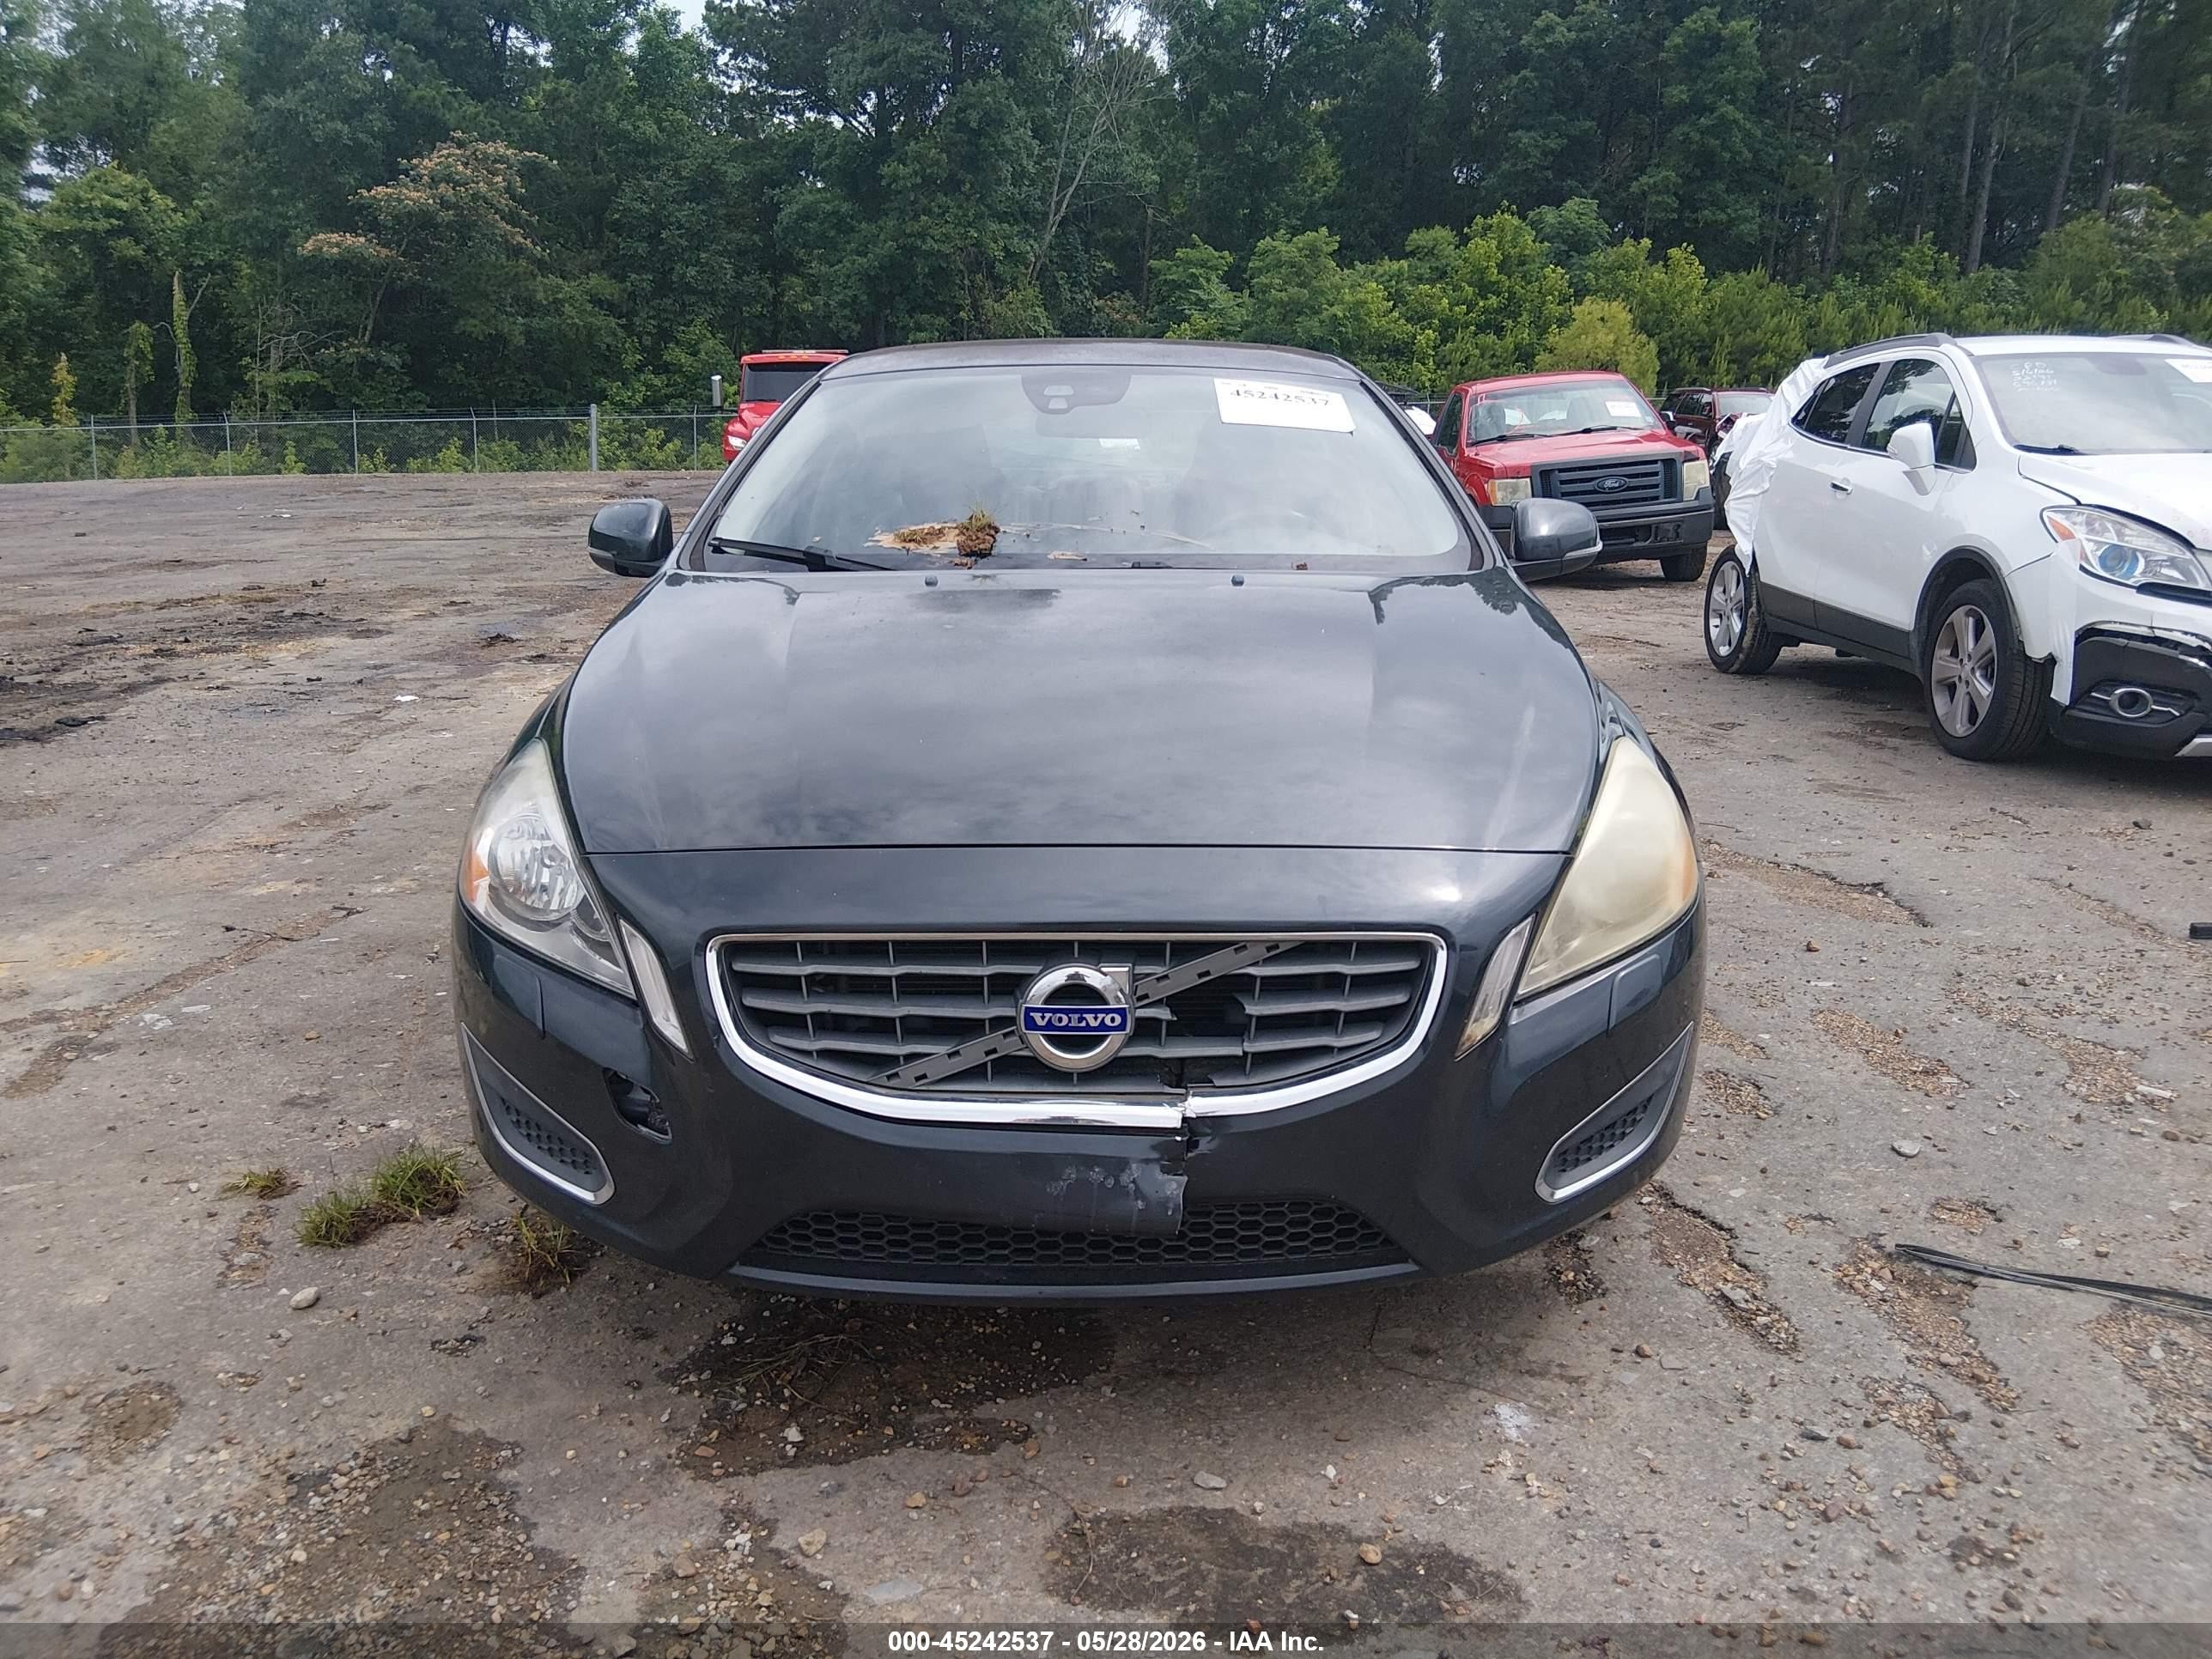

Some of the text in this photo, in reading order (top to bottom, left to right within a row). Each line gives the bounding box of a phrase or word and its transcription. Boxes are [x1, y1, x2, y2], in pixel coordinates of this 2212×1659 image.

[1230, 389, 1329, 406] 45242537
[1603, 478, 1620, 489] Ford
[1030, 1012, 1121, 1027] VOLVO
